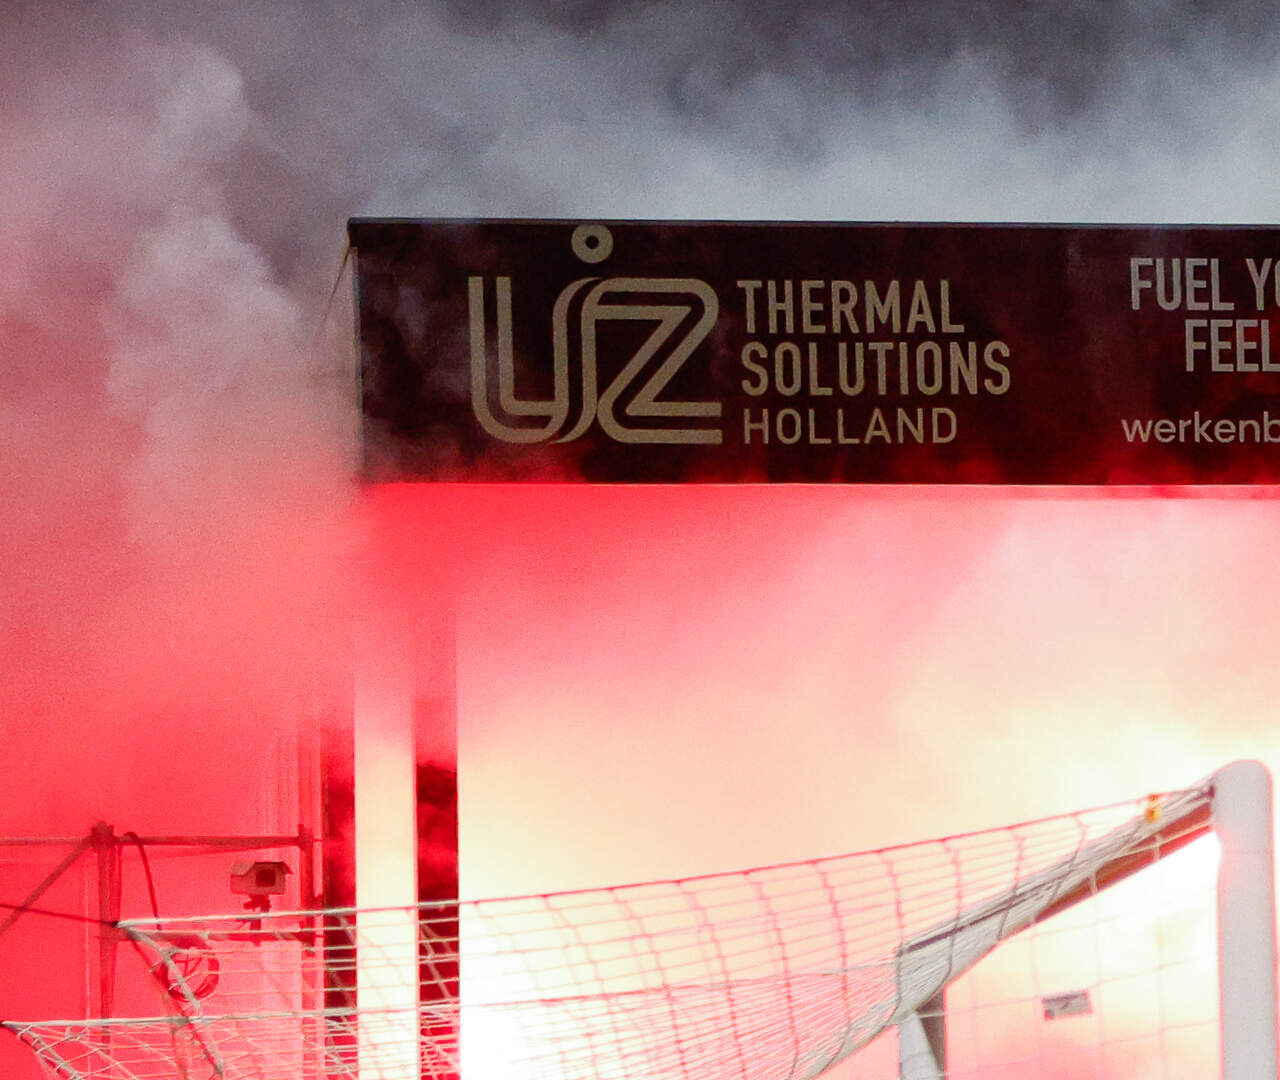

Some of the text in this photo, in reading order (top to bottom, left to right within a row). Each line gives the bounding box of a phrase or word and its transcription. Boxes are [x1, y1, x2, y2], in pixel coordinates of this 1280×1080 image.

[736, 279, 966, 335] THERMAL
[1129, 256, 1235, 311] FUEL
[740, 340, 1012, 397] SOLUTIONS
[743, 407, 959, 445] HOLLAND
